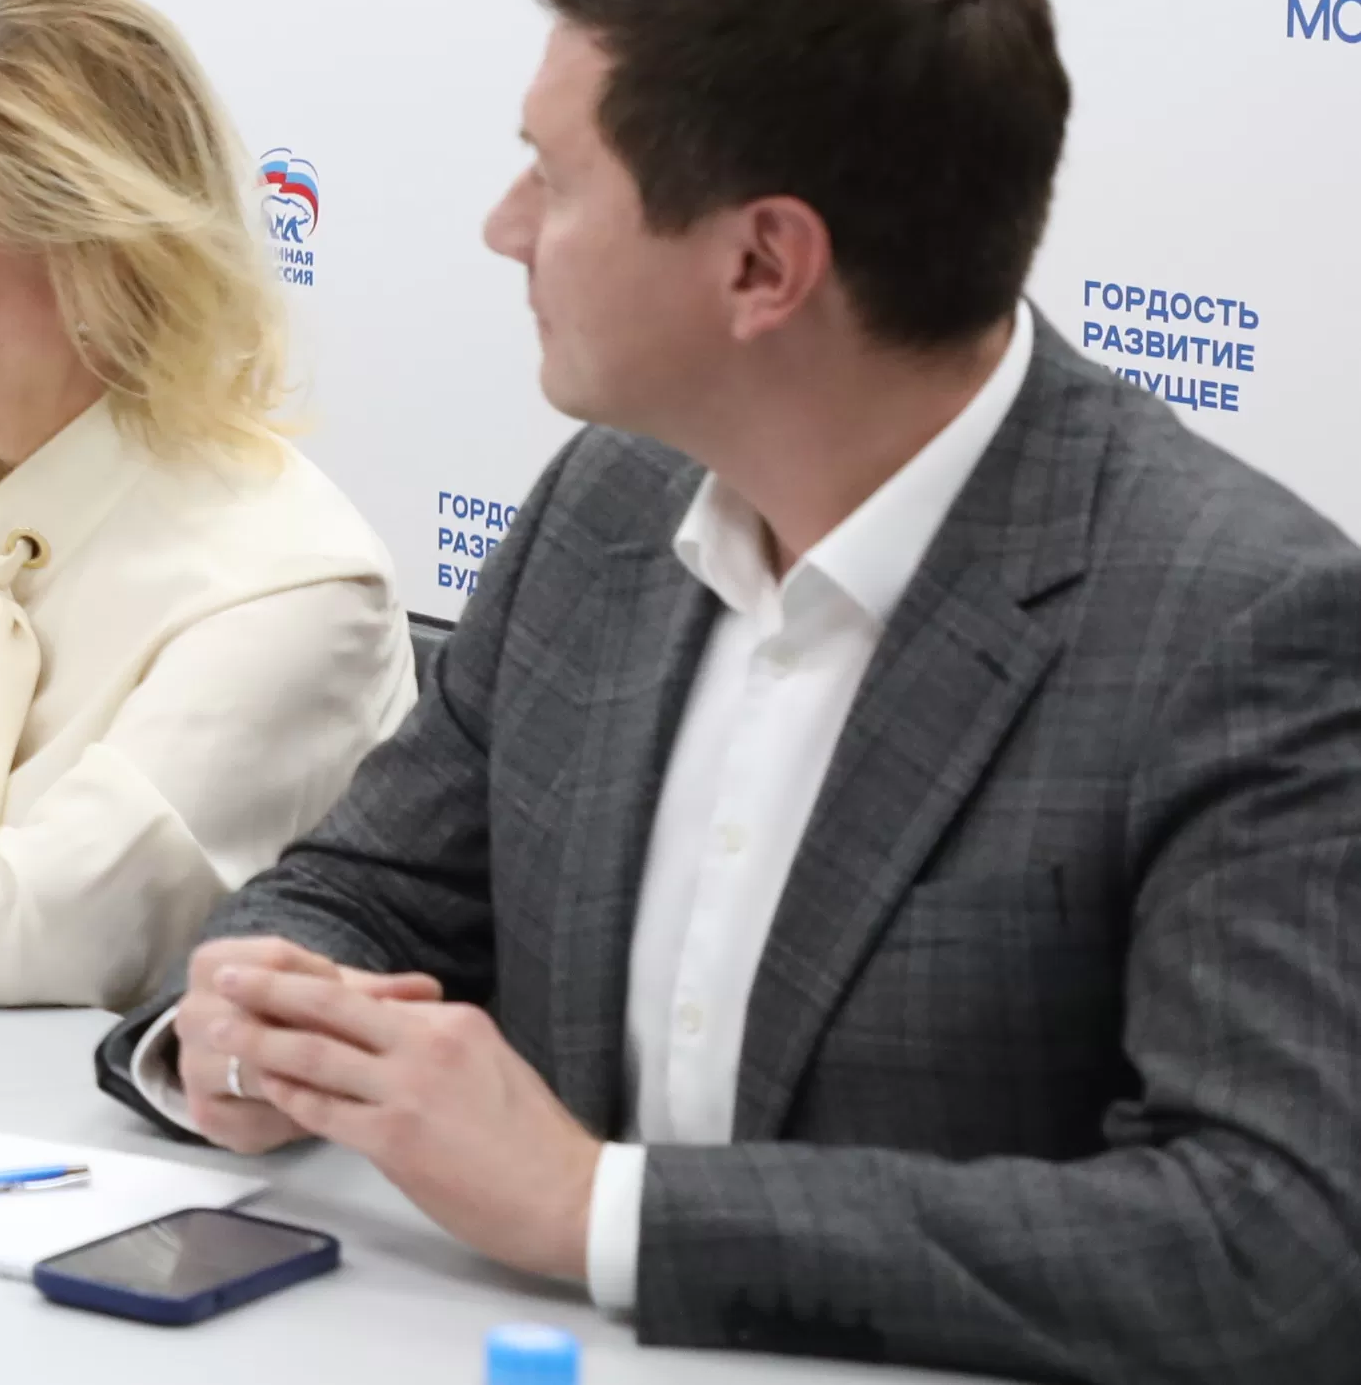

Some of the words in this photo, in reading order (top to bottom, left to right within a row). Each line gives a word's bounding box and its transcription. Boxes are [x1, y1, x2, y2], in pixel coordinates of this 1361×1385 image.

[279, 246, 314, 267] НАЯ
[279, 265, 314, 287] СИЯ
[1083, 280, 1260, 330] ГОРДОСТЬ
[1083, 321, 1256, 372] РАЗВИТИЕ
[439, 491, 519, 532] ГОРДО
